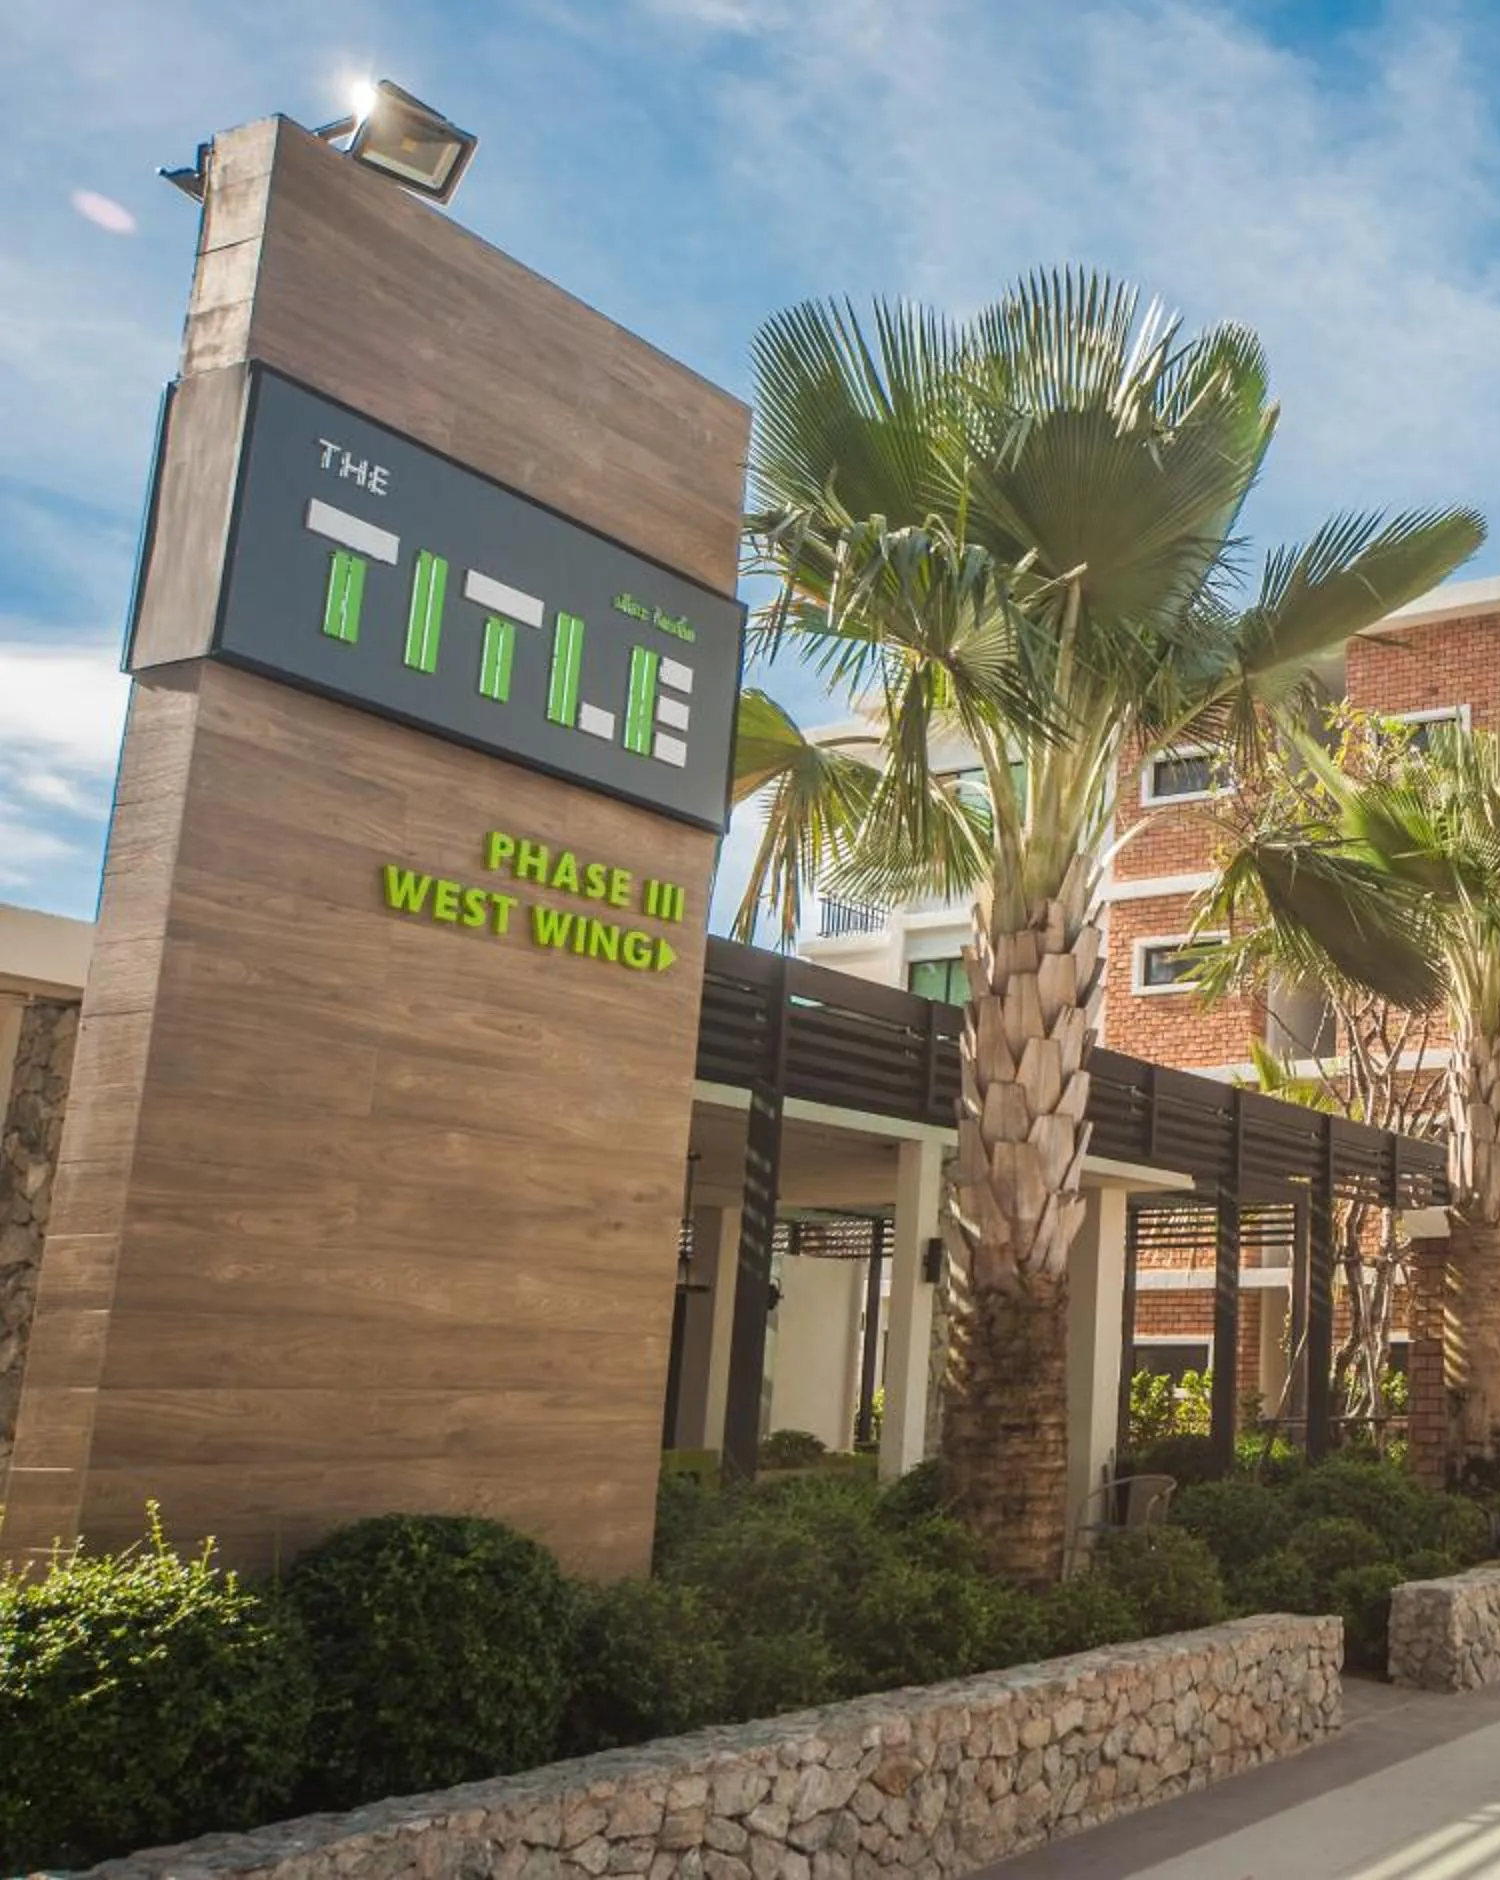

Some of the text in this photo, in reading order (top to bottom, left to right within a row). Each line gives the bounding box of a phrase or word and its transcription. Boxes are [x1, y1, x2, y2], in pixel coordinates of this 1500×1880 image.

[318, 437, 391, 496] THE
[305, 498, 694, 768] TITLE
[382, 863, 652, 970] WEST WING
[485, 830, 685, 922] PHASE III
